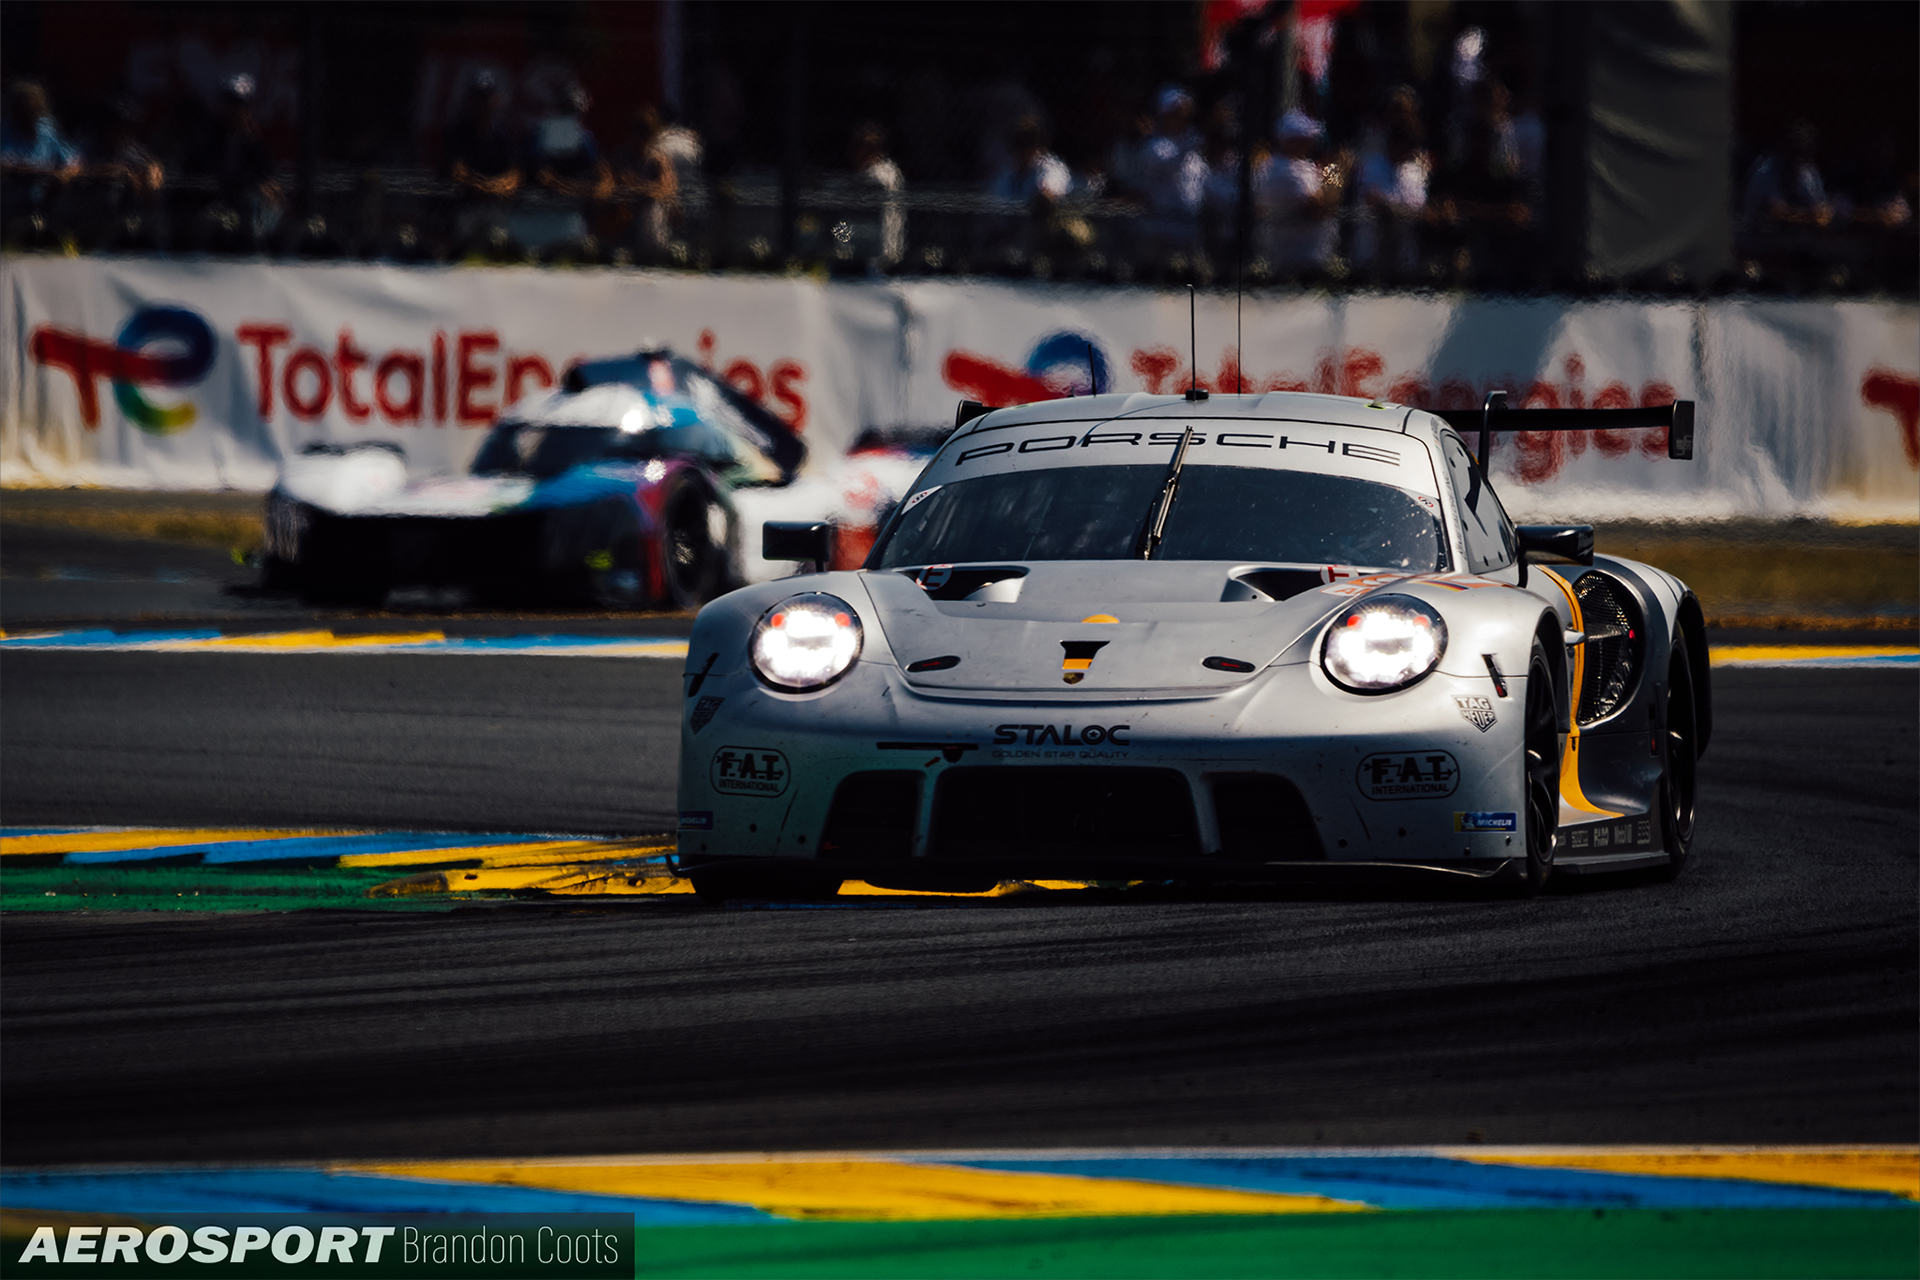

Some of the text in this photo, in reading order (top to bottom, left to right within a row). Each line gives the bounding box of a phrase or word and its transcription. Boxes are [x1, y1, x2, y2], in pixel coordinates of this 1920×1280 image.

[236, 322, 808, 430] TotalEnes
[955, 432, 1401, 467] PORSCHE
[698, 699, 719, 710] TAG
[1456, 697, 1490, 710] TAG
[1461, 710, 1495, 728] HEUER
[993, 724, 1131, 746] STALOC
[992, 749, 1130, 759] GOLDEN STAR QUALITY
[718, 779, 780, 793] INTERNATIONAL
[1371, 783, 1450, 796] INTERNATIONAL
[1475, 818, 1513, 827] MICHELIN
